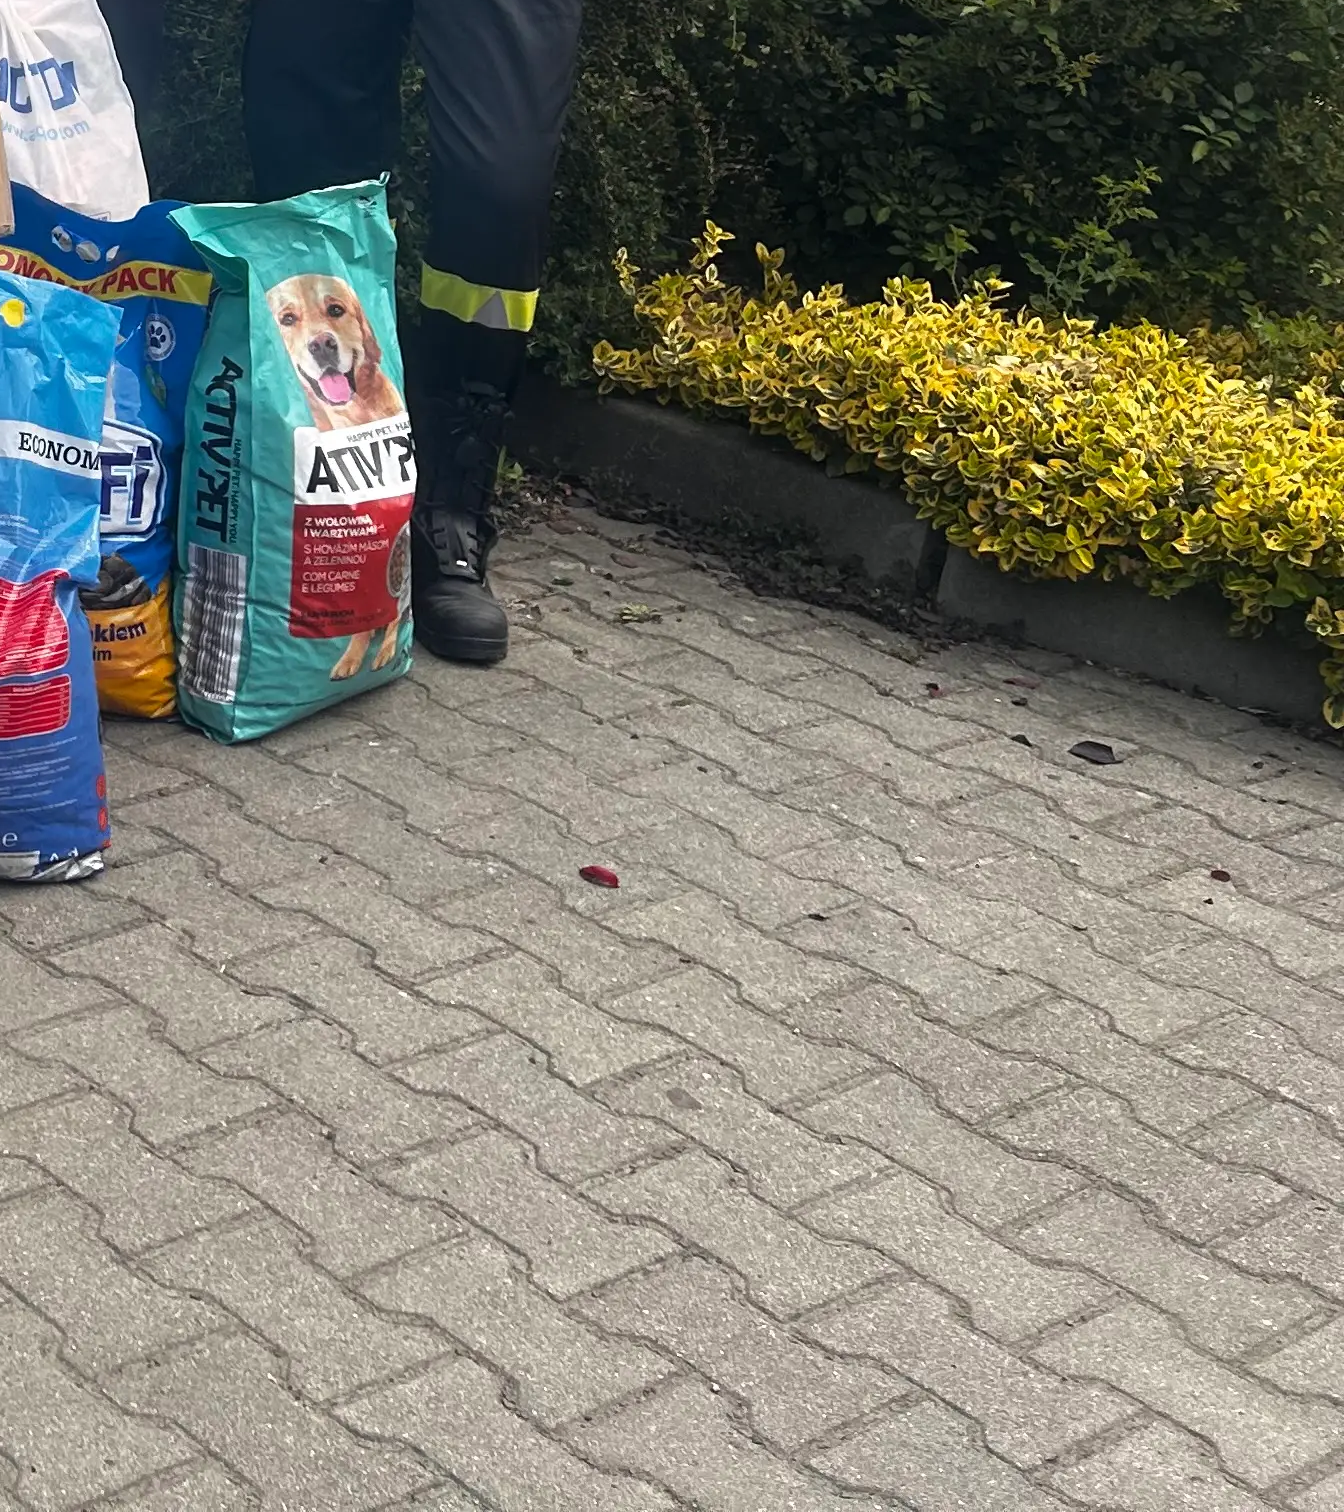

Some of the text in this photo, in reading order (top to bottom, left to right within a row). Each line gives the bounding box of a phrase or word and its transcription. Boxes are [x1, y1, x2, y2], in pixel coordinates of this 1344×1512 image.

[101, 266, 180, 295] PACK
[346, 429, 374, 444] HAPPY
[17, 431, 100, 471] ECONOM
[305, 517, 314, 527] Z
[303, 525, 378, 539] I WARZYWAMI
[303, 544, 312, 555] S
[303, 554, 367, 567] A ZELENINOU
[302, 569, 361, 582] COM CARNE
[301, 581, 357, 594] E LEGUMES
